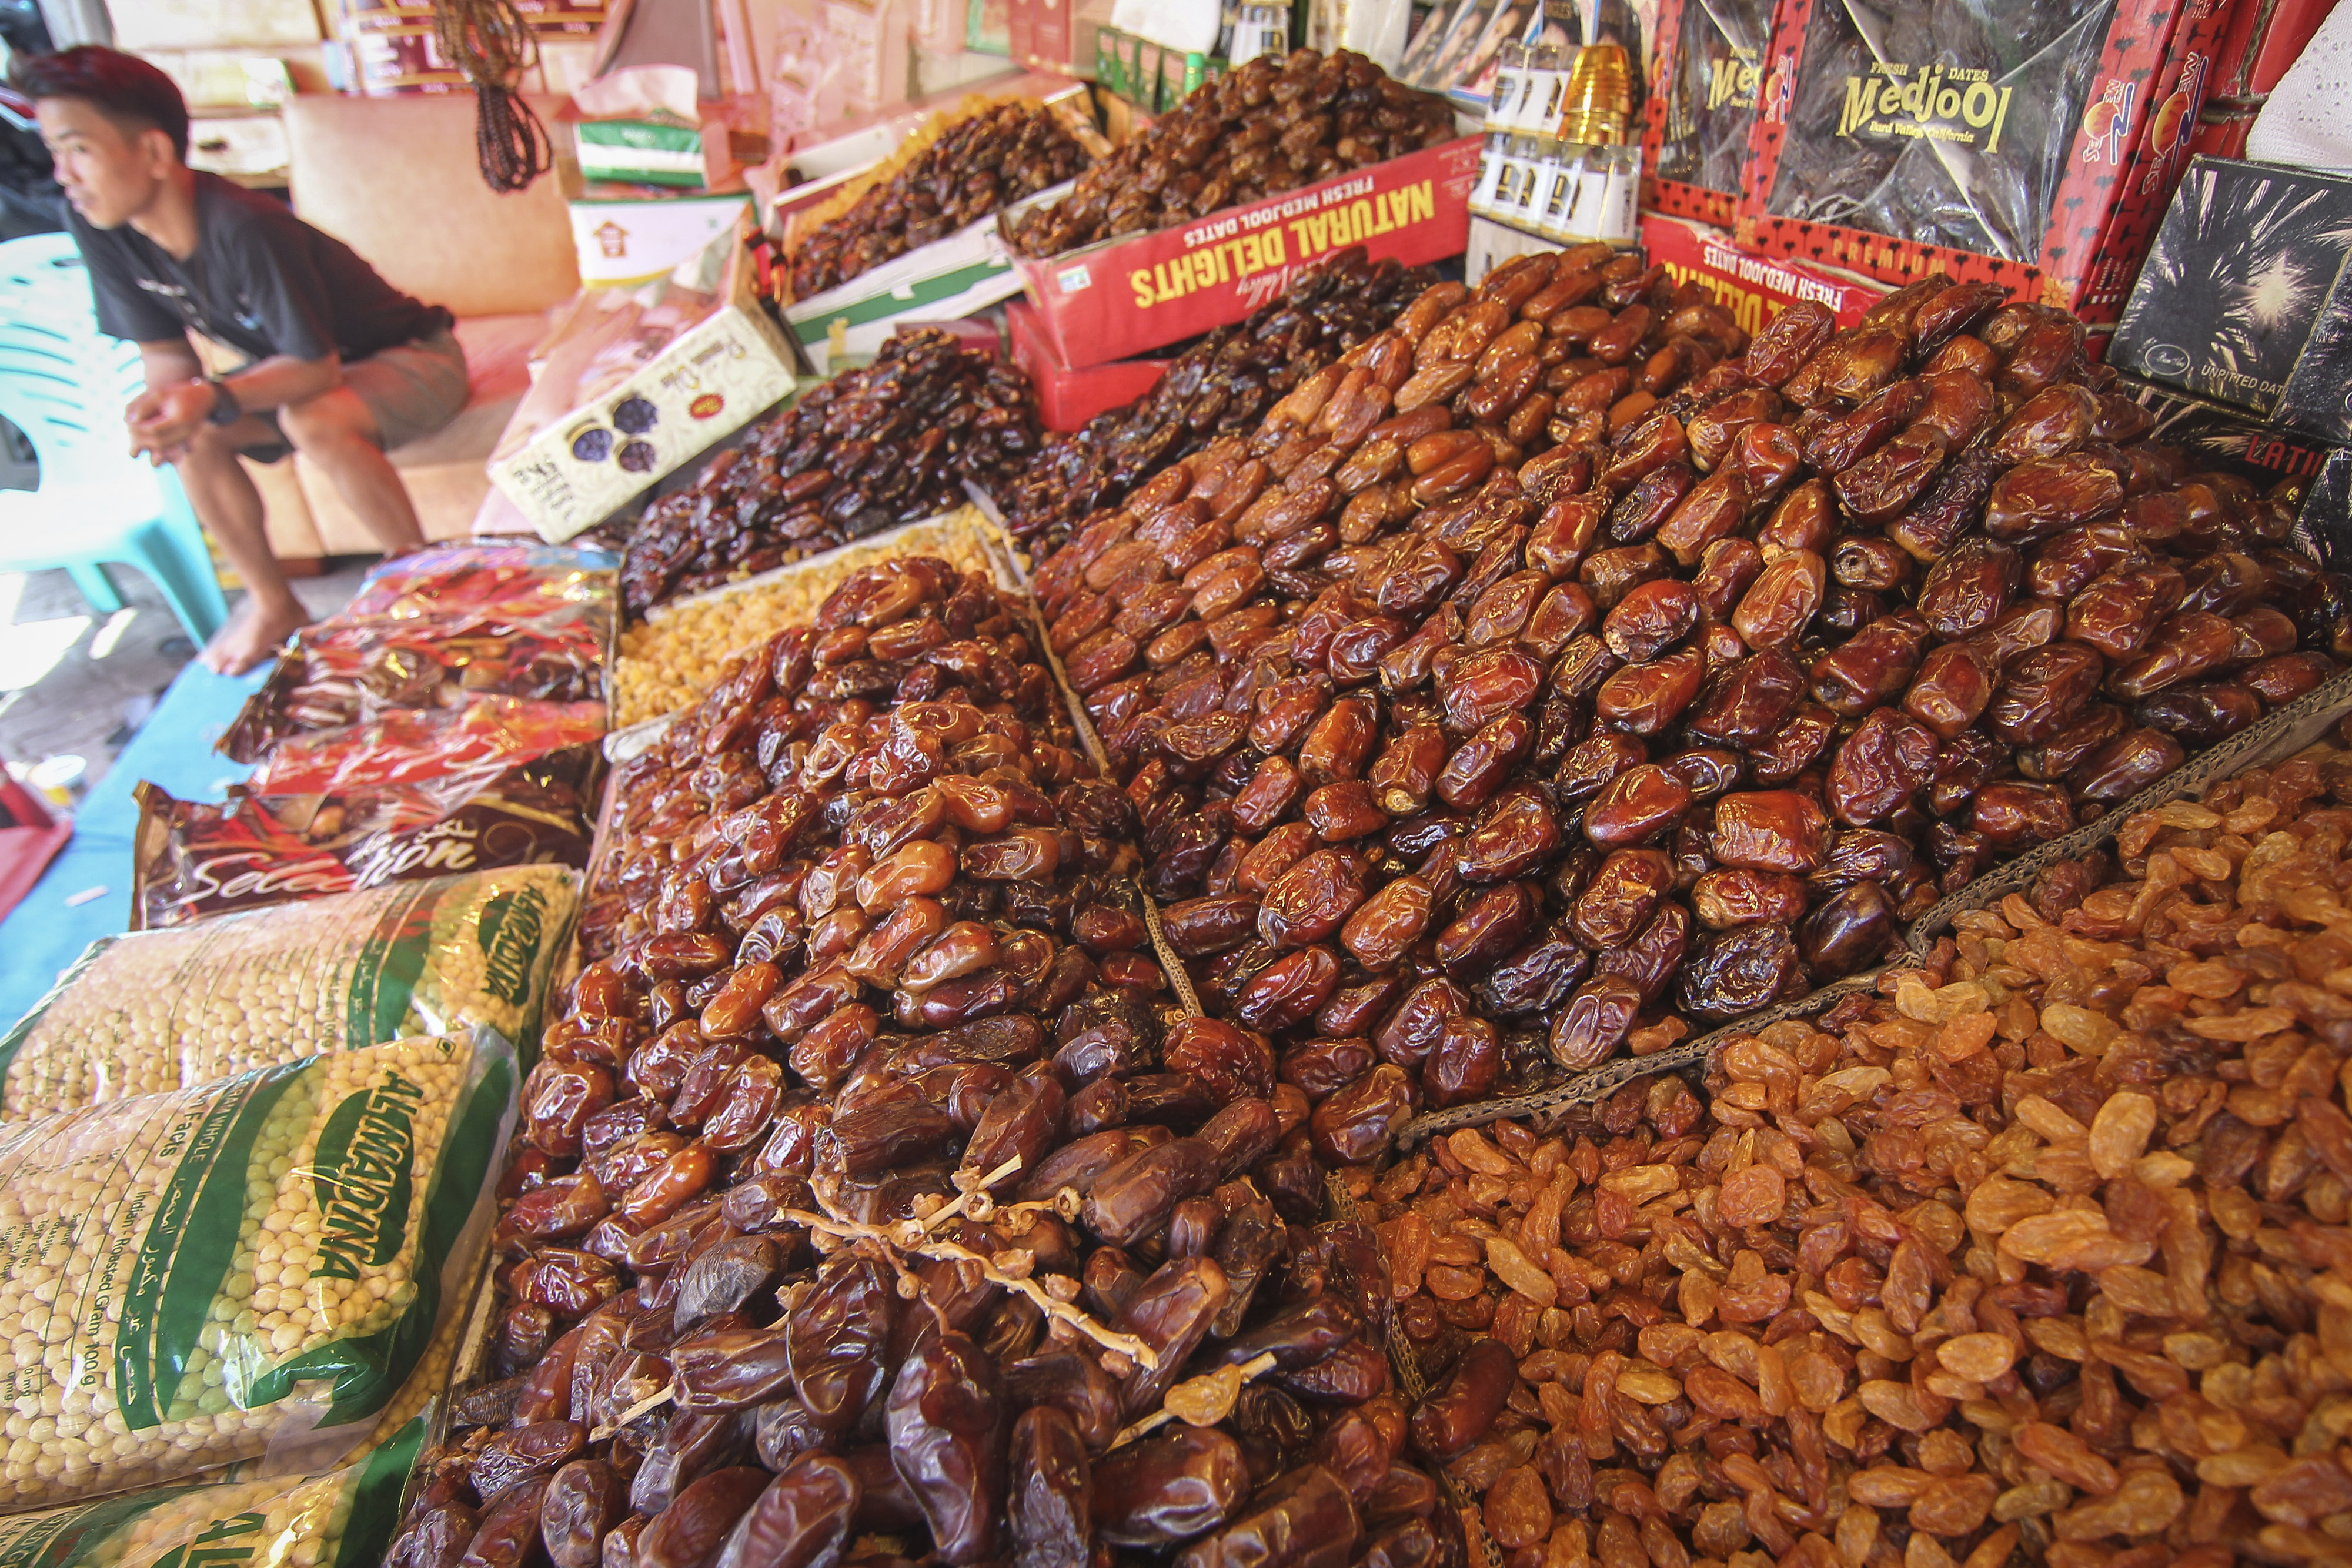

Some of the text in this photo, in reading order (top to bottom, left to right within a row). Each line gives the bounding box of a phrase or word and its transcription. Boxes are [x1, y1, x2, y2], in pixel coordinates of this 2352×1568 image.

[1948, 67, 1989, 82] DATES
[1183, 175, 1374, 249] FRESH MEDJOOL DATES
[1130, 178, 1435, 309] NATURAL DELIGHTS
[1703, 245, 1738, 276] DATES
[1737, 258, 1798, 297] MEDJOOL
[1798, 276, 1843, 312] FRESH
[2201, 364, 2258, 389] UNPITTED
[158, 1111, 205, 1158] Facts
[188, 1115, 228, 1164] WHOLE
[121, 1191, 149, 1229] Indian
[8, 1222, 32, 1255] Dietary
[19, 1219, 49, 1269] Total Carbs
[38, 1216, 65, 1261] Potassium
[60, 1213, 82, 1245] Sodium
[98, 1238, 129, 1292] Roasted
[86, 1295, 111, 1336] Gram
[83, 1342, 101, 1369] 100
[4, 1381, 15, 1400] mg
[21, 1379, 32, 1398] mg
[81, 1375, 97, 1386] g
